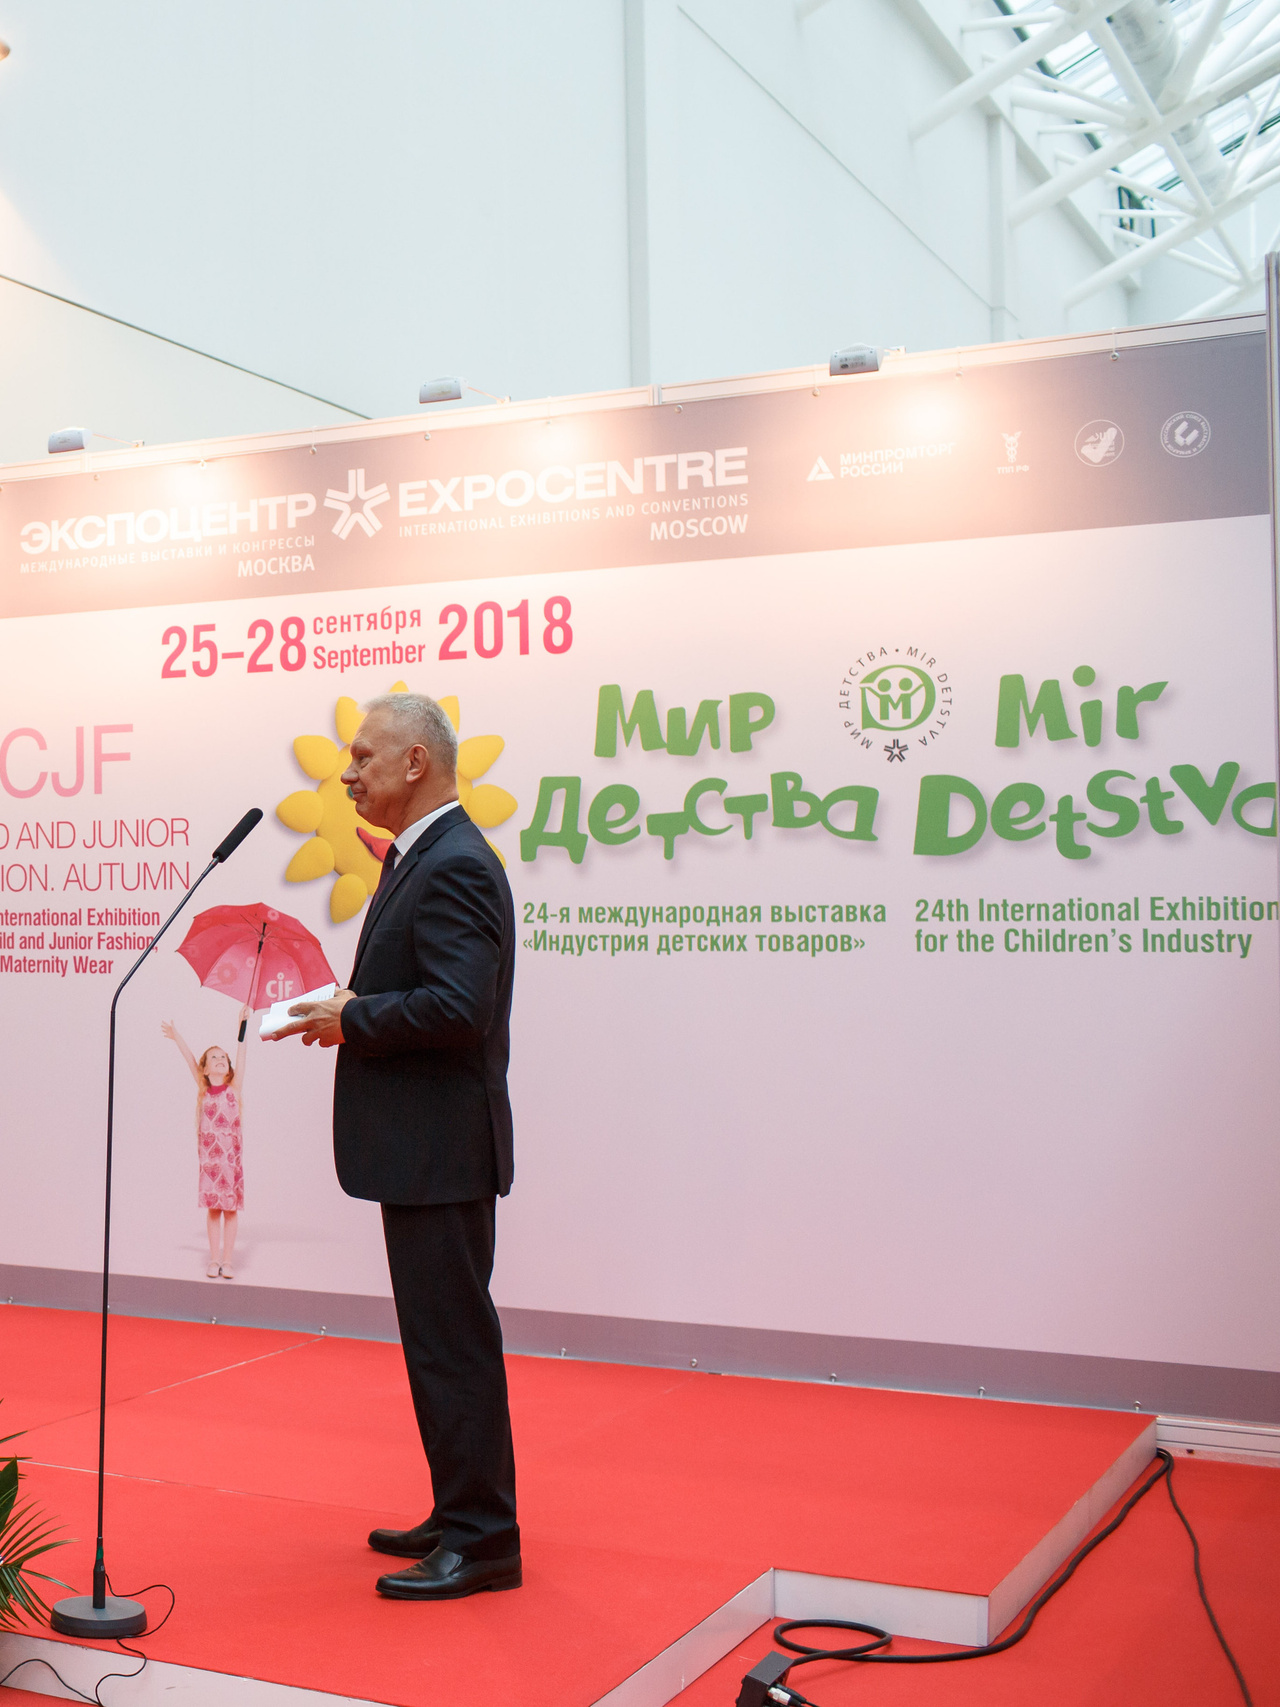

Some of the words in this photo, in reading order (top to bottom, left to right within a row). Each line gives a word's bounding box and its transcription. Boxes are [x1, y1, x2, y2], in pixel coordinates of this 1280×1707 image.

[840, 442, 957, 466] МИНПРОМТОРГ
[398, 446, 749, 517] EXPOCENTRE
[840, 461, 904, 478] РОССИИ
[20, 492, 317, 555] ЭКСПОЦЕНТР
[399, 516, 505, 538] INTERNATIONAL
[510, 507, 600, 528] EXHIBITIONS
[605, 504, 636, 519] AND
[641, 493, 749, 515] CONVENTIONS
[650, 514, 749, 541] MOSCOW
[20, 553, 136, 574] МЕЖДУНАРОДНЫЕ
[141, 545, 213, 563] ВЫСТАВКИ
[218, 544, 227, 556] И
[232, 535, 315, 554] КОНГРЕССЫ
[237, 554, 315, 577] МОСКВА
[312, 606, 422, 635] сентября
[438, 595, 573, 661] 2018
[313, 641, 426, 673] September
[906, 646, 936, 668] MIR
[839, 646, 888, 709] ДЕТСТВА
[918, 673, 952, 746] DETSTVA
[994, 665, 1169, 748] Mir
[15, 821, 76, 850] AND
[82, 818, 190, 849] JUNIOR
[63, 861, 190, 892] AUTUMN
[87, 908, 160, 926] Exhibition
[523, 902, 571, 924] 24-я
[578, 903, 762, 928] международная
[770, 903, 887, 923] выставка
[915, 898, 969, 922] 24th
[978, 897, 1140, 922] International
[1150, 896, 1279, 921] Exhibition
[19, 932, 45, 950] and
[49, 932, 94, 950] Junior
[522, 929, 649, 956] «Индустрия
[657, 932, 748, 955] детских
[755, 933, 866, 957] товаров»
[915, 928, 948, 952] for
[956, 929, 994, 953] the
[1142, 928, 1253, 959] Industry
[0, 955, 68, 977] Maternity
[73, 955, 114, 974] Wear
